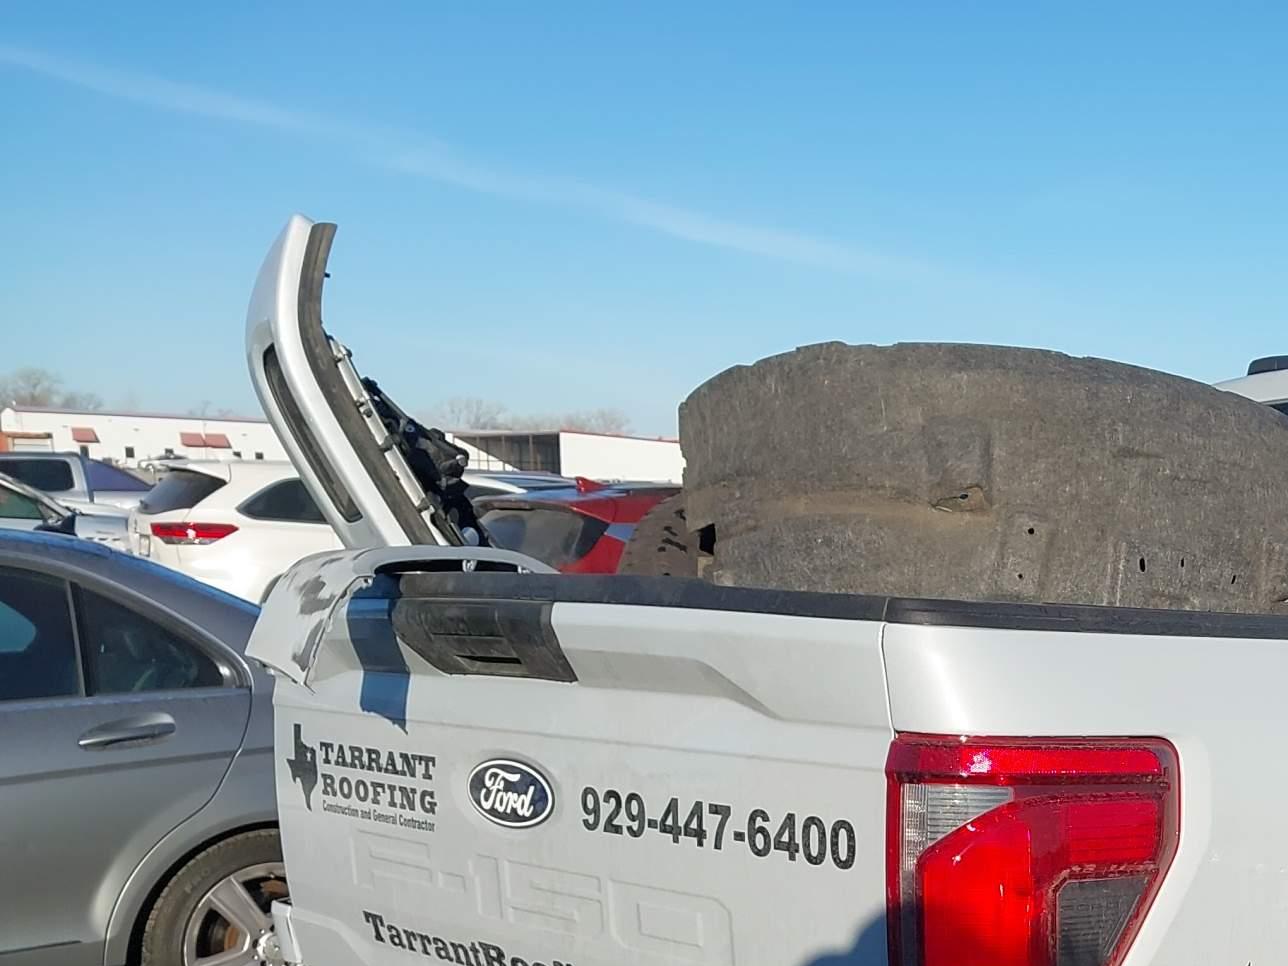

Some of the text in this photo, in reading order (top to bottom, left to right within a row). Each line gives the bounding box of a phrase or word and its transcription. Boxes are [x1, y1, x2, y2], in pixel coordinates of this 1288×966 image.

[319, 741, 436, 780] TARRANT
[320, 773, 437, 815] ROOFING
[480, 768, 533, 818] Ford
[580, 786, 856, 870] 929-447-6400
